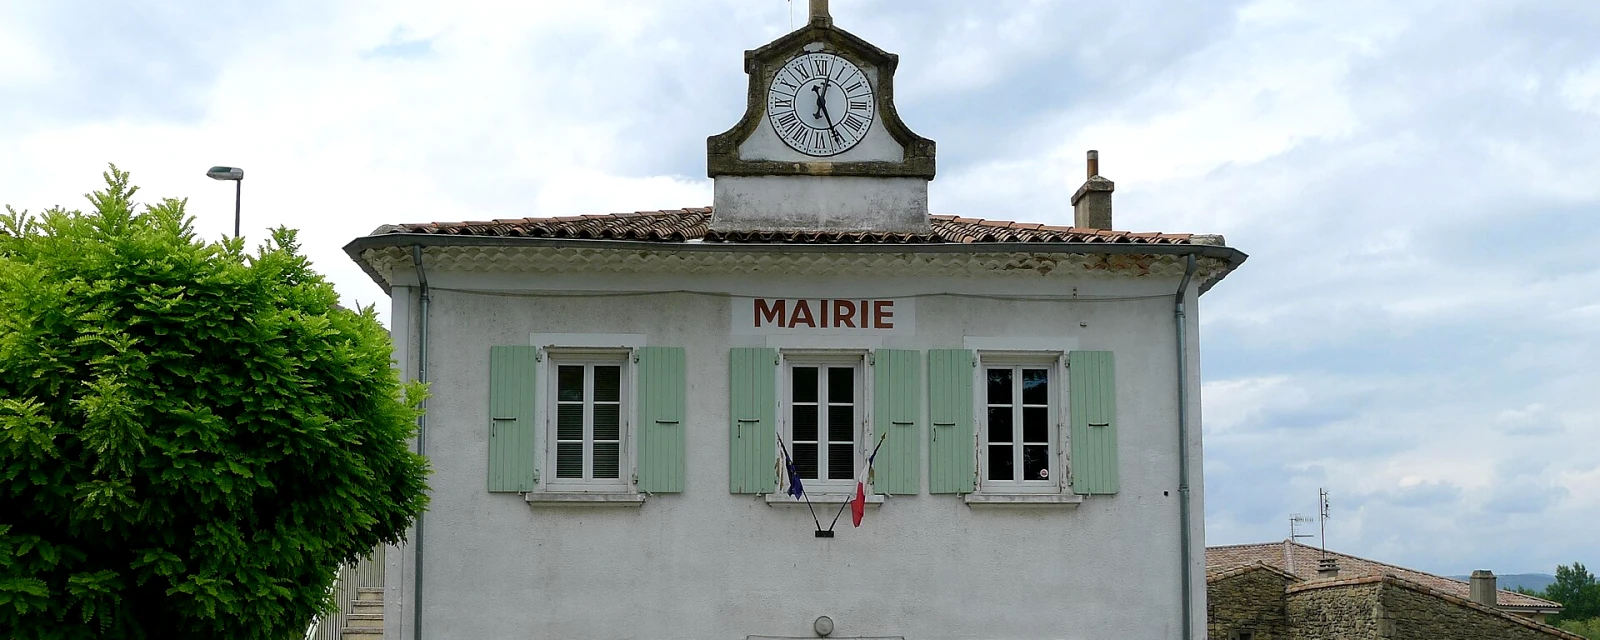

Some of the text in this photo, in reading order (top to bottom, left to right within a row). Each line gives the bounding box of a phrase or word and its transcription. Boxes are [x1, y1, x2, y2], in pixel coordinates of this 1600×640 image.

[794, 63, 810, 80] XI
[814, 60, 828, 76] XII
[779, 78, 797, 91] X
[845, 81, 862, 93] II
[774, 97, 792, 108] IX
[850, 101, 867, 110] III
[778, 112, 799, 133] VIII
[844, 114, 863, 132] IIII
[792, 125, 809, 145] VII
[814, 131, 826, 149] VI
[754, 298, 894, 328] MAIRIE
